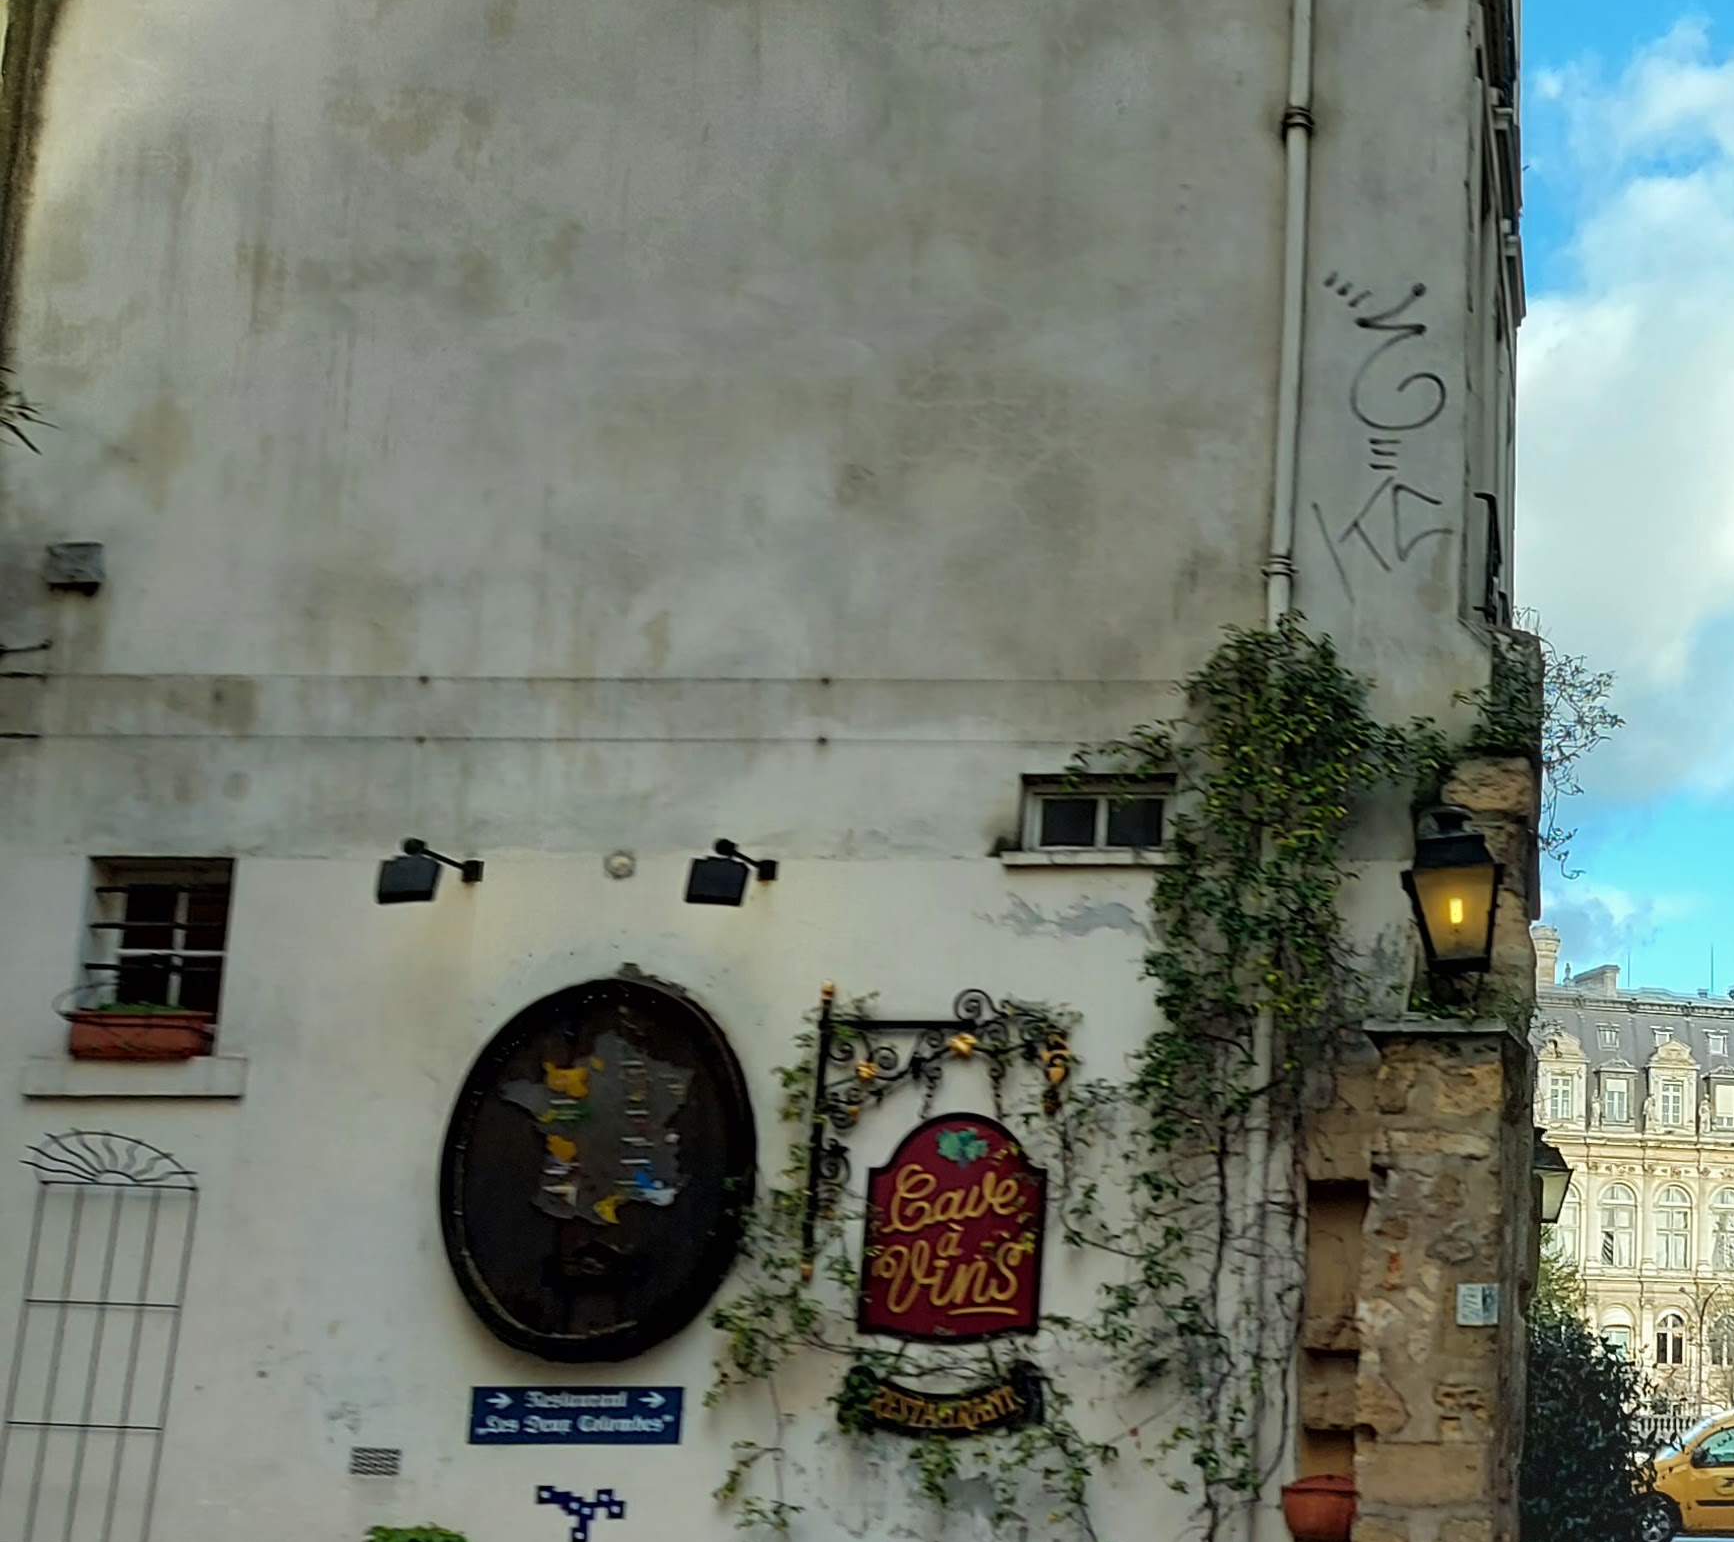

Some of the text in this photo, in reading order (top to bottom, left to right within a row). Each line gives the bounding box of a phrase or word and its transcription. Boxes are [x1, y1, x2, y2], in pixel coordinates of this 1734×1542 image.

[881, 1163, 1018, 1232] Cave
[873, 1238, 1023, 1313] Vins
[937, 1224, 963, 1258] à
